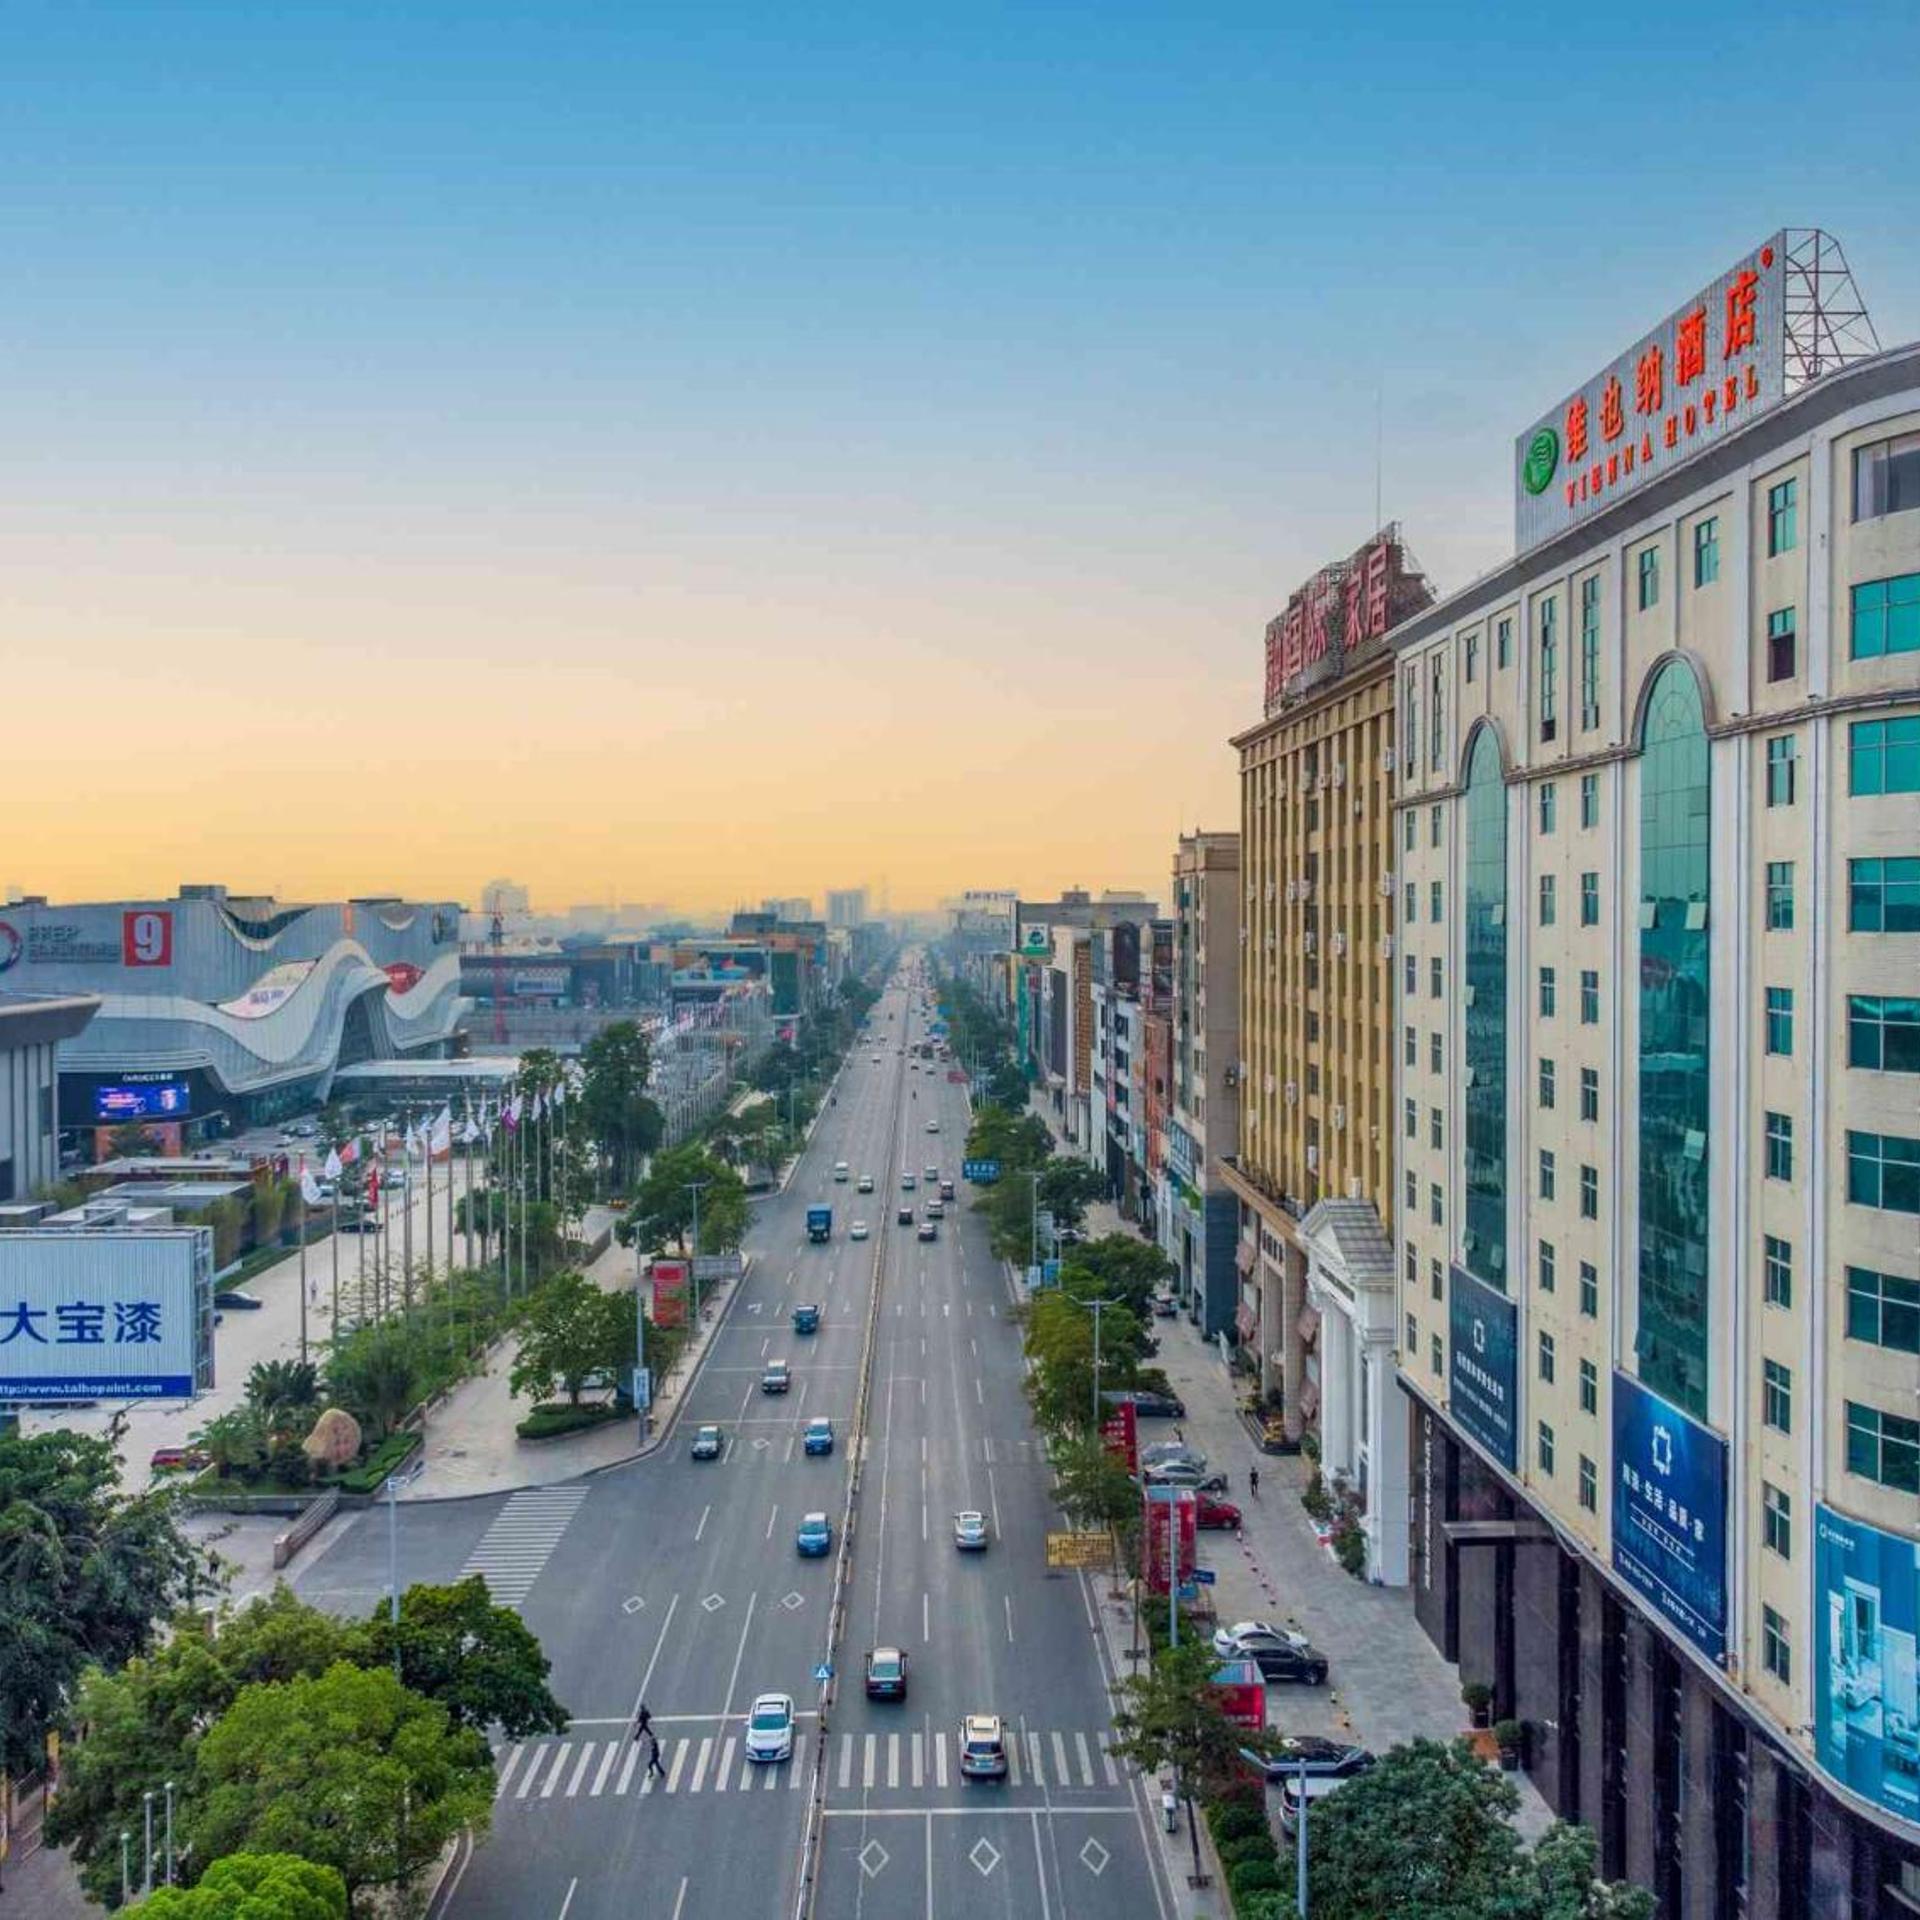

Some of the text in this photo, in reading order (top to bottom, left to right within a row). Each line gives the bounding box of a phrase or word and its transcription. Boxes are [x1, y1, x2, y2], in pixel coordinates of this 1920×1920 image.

[1565, 271, 1758, 462] 维也纳酒店
[1566, 365, 1758, 507] VIENNA HOTEL
[134, 914, 163, 961] 9
[0, 1301, 162, 1344] 大宝漆
